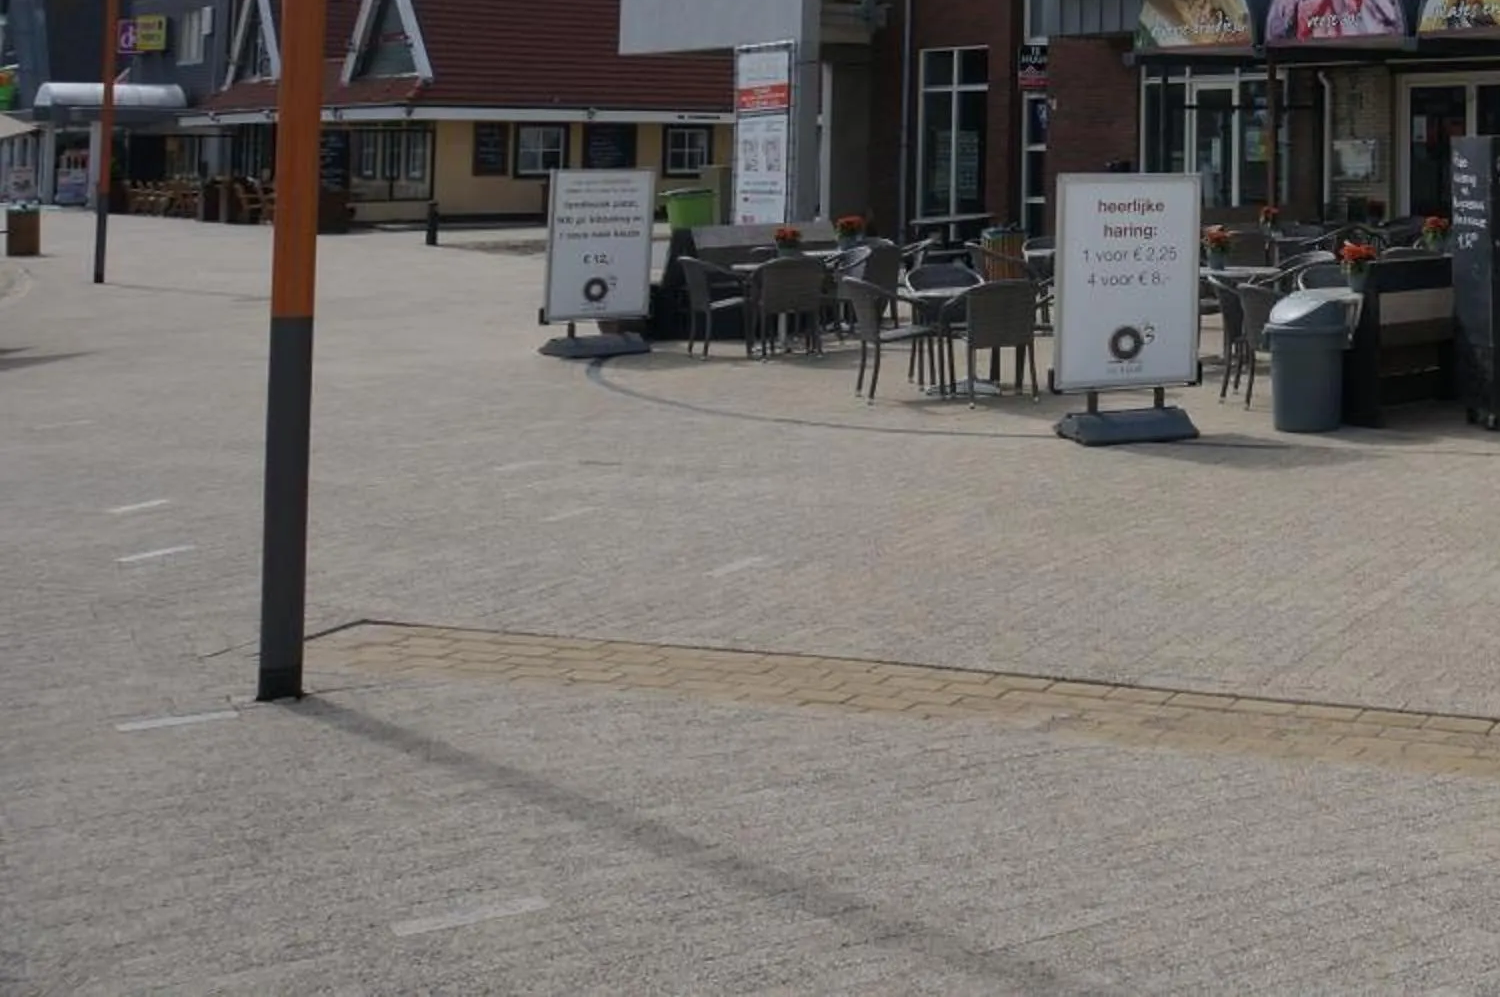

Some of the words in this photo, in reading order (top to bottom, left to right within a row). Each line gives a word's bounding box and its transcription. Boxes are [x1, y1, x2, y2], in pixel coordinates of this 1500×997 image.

[1097, 198, 1166, 216] heerlijke
[1103, 224, 1159, 240] haring:
[1095, 249, 1128, 263] voor
[1087, 272, 1097, 287] 4
[1101, 273, 1135, 287] voor
